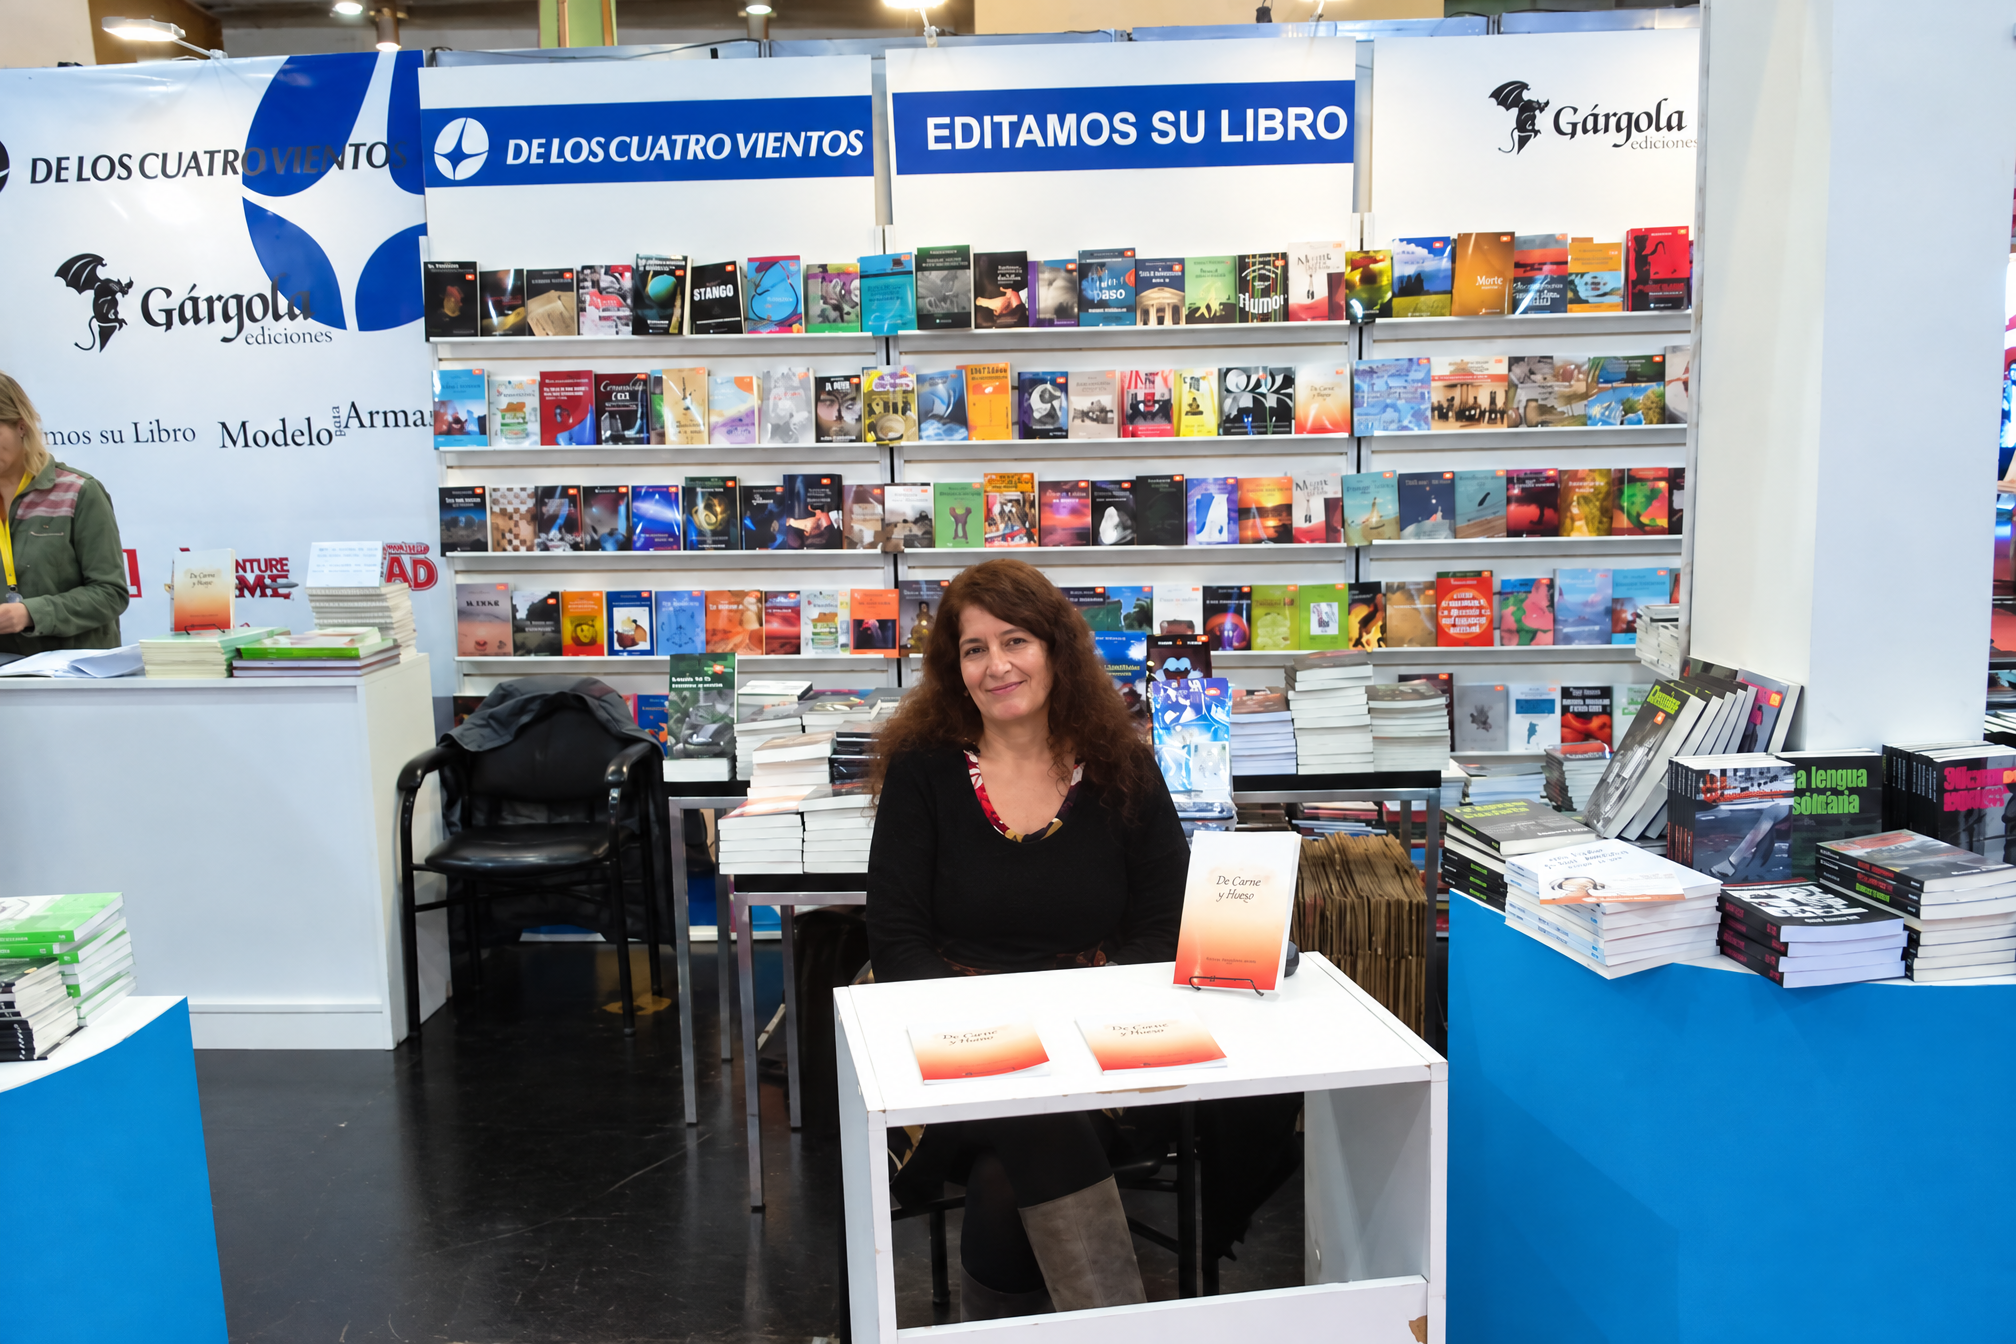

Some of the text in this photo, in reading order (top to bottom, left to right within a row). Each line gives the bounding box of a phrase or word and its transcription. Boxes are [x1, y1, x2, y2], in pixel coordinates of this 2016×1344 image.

[926, 105, 1348, 151] EDITAMOS SU LIBRO
[1553, 97, 1688, 149] Gárgola
[506, 128, 864, 165] DE LOS CUATRO VIENTOS
[29, 140, 408, 184] DE LOS CUATRO VIENTOS
[693, 283, 734, 301] STANGO
[140, 272, 316, 344] Gárgola
[244, 323, 333, 347] ediciones
[99, 425, 125, 445] su
[132, 418, 196, 445] Libro
[217, 416, 333, 449] Modelo
[235, 557, 290, 574] NTURE
[235, 574, 294, 600] ME
[1811, 766, 1868, 791] lengua
[1216, 875, 1262, 887] De Carne
[1216, 888, 1255, 904] y Hueso
